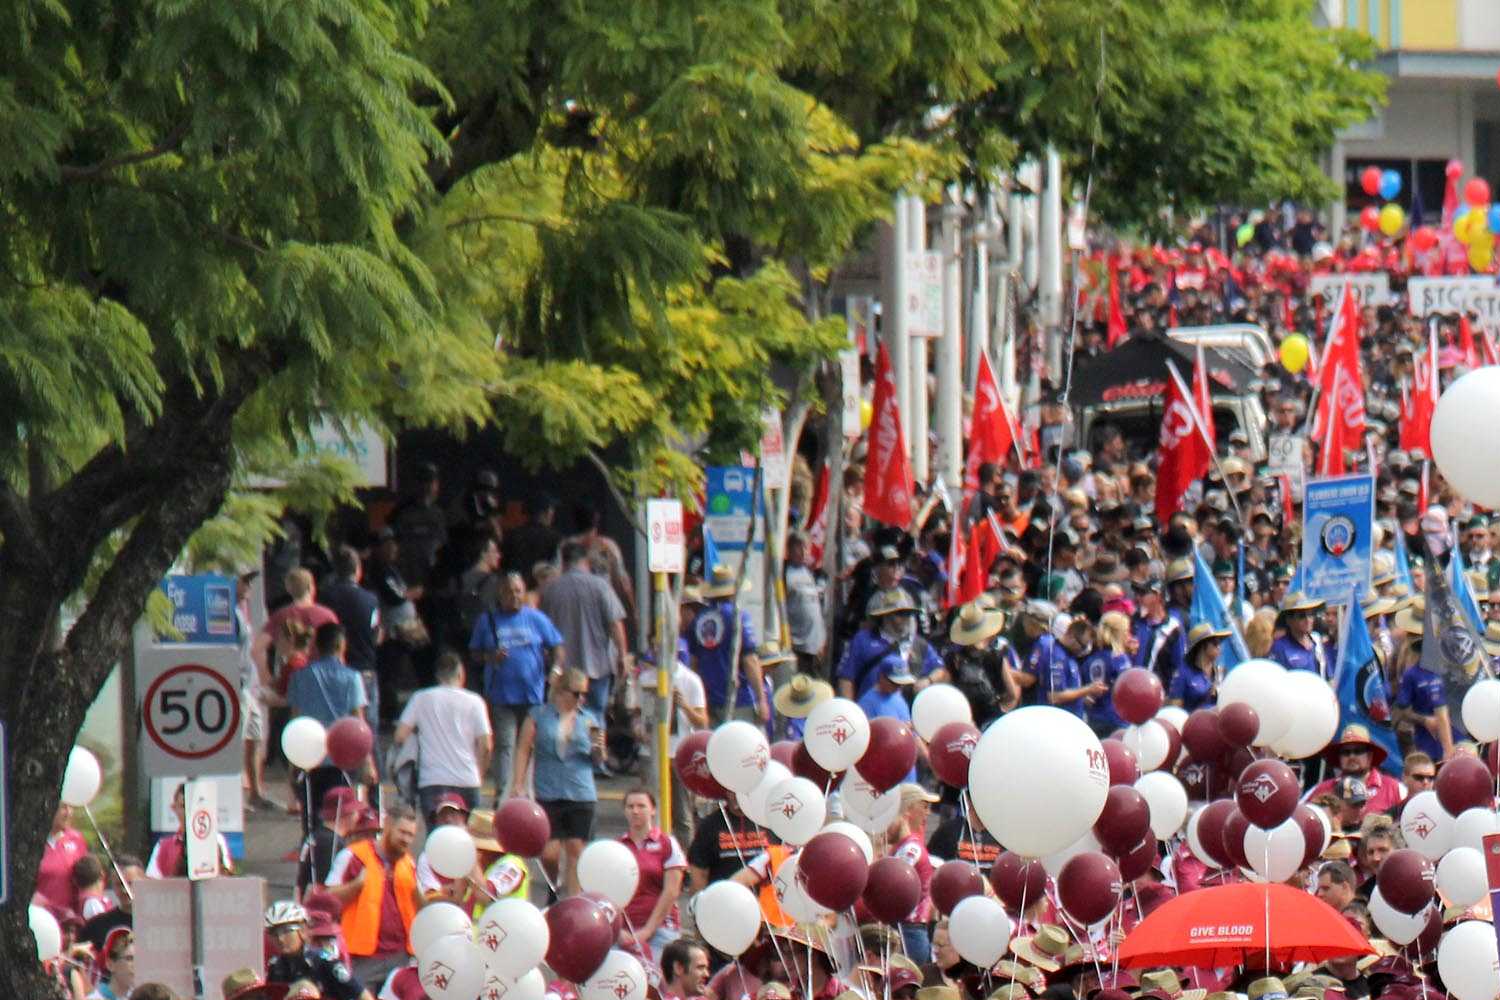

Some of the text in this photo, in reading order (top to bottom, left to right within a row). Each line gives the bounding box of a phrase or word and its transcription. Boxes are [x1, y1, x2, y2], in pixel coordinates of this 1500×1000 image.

[160, 688, 227, 735] 50
[1190, 924, 1254, 938] GIVE BLOOD
